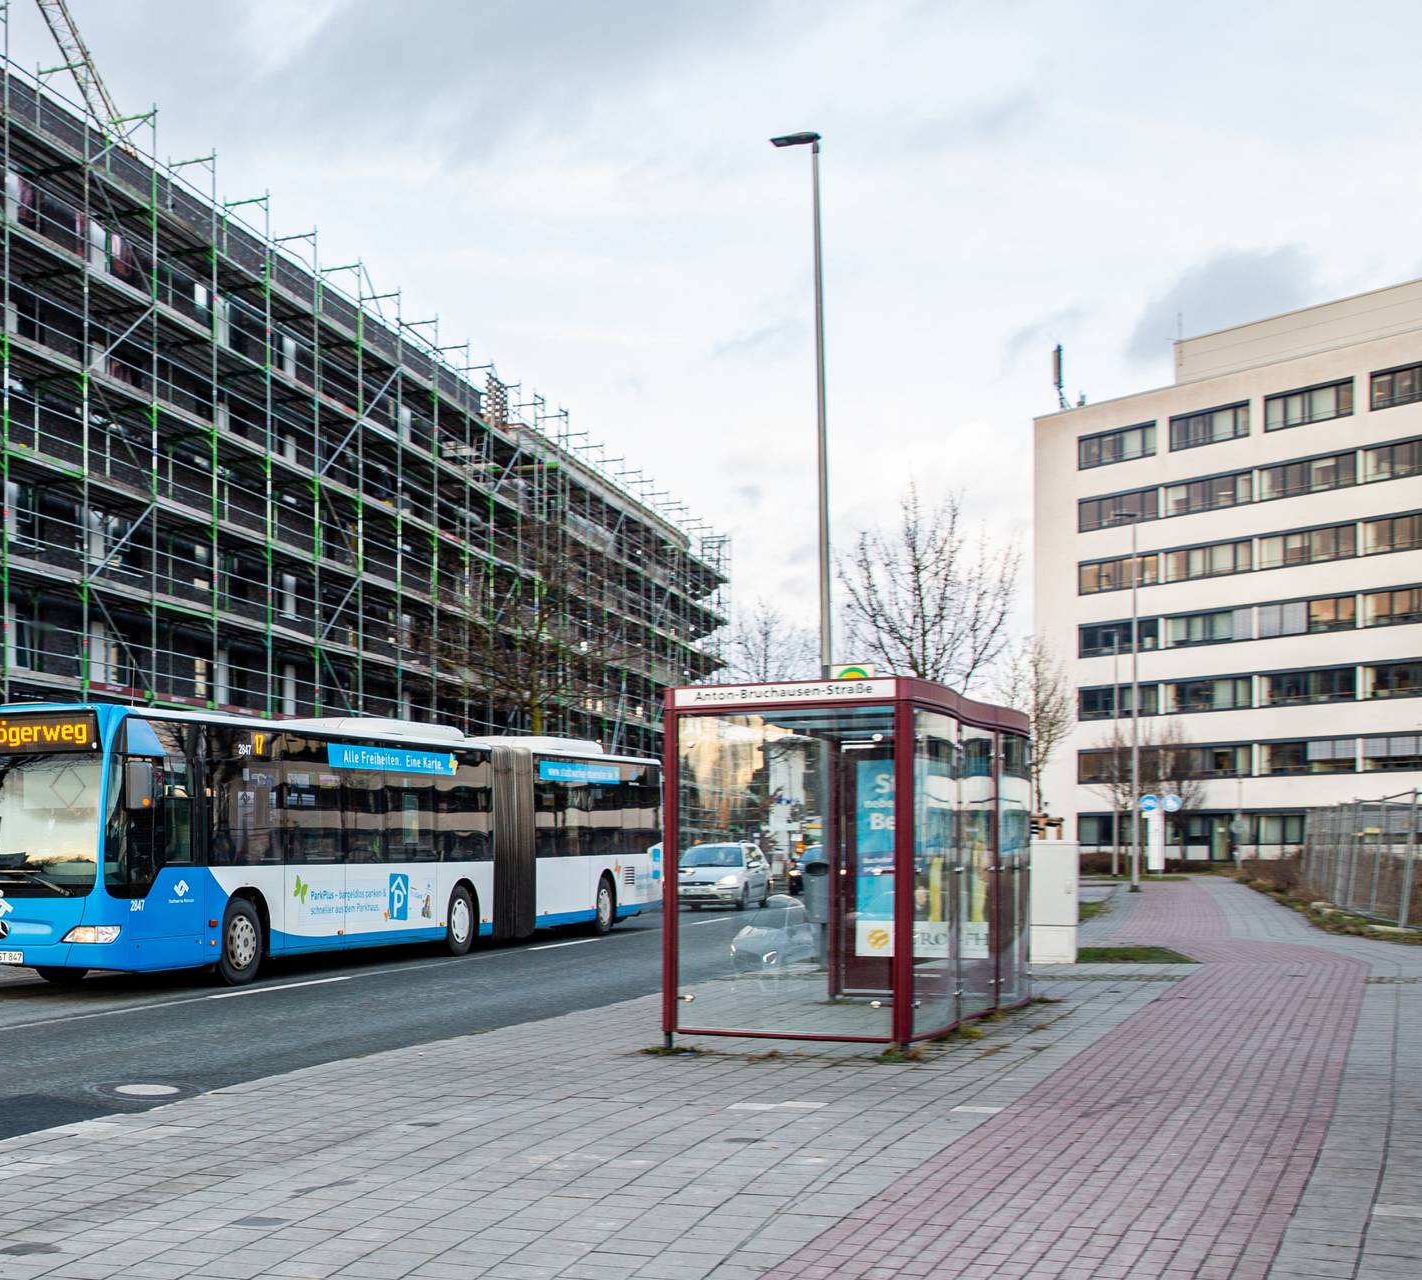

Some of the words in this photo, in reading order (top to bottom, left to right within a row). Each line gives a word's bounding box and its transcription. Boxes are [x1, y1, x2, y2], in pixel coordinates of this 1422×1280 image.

[695, 683, 873, 701] Anton-Bruchausen-Straße
[238, 744, 252, 756] 2847
[255, 735, 264, 755] 17
[343, 750, 359, 763] Alle
[361, 751, 402, 767] Freiheiten.
[406, 755, 421, 768] Eine
[423, 757, 444, 770] Karte.
[310, 890, 334, 901] ParkPlus
[130, 899, 145, 911] 2847
[393, 890, 404, 918] P
[9, 953, 22, 962] 847
